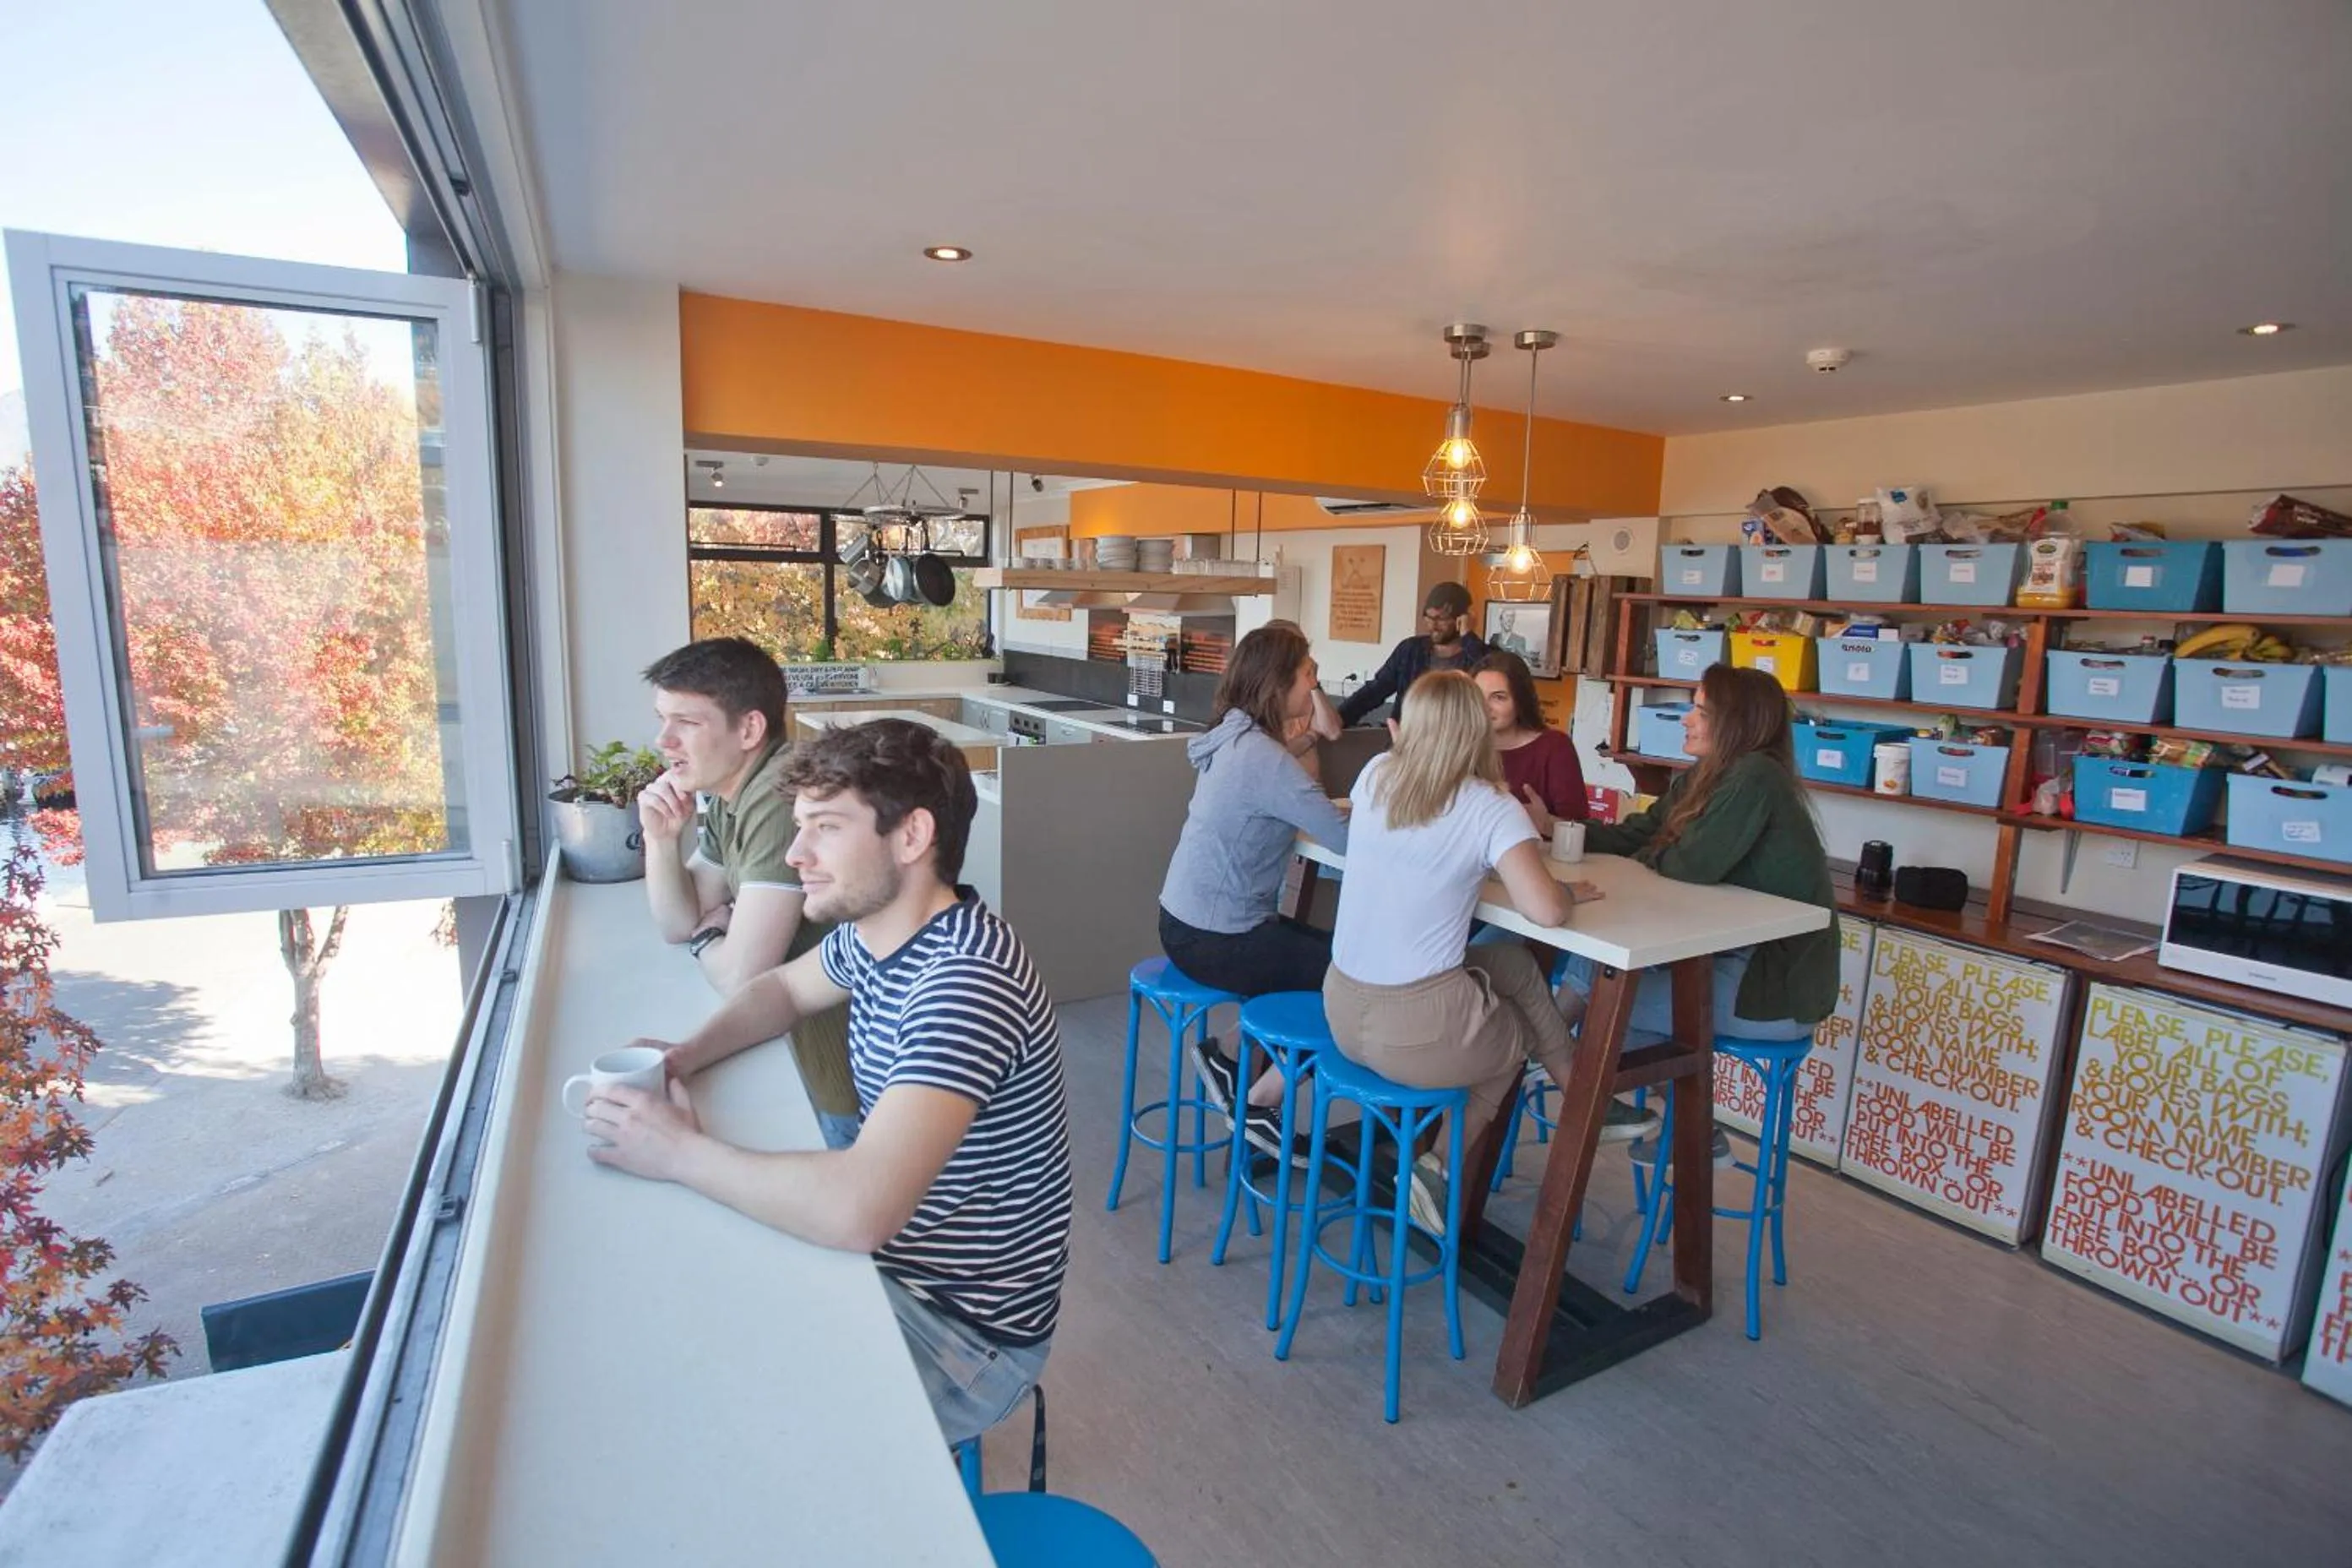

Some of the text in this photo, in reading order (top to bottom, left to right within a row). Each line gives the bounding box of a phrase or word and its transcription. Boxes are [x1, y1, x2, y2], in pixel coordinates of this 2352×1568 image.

[1873, 956, 2022, 1016] LABEL ALL OF
[1876, 939, 1954, 977] PLEASE,
[1961, 962, 2053, 1005] PLEASE,
[1867, 1010, 1923, 1043] YOUR
[1928, 1029, 2002, 1068] NAME
[1871, 993, 1889, 1014] &
[1890, 999, 1962, 1037] BOXES
[1965, 1020, 2039, 1062] WITH;
[1892, 982, 1953, 1015] YOUR
[1957, 1000, 2025, 1037] BAGS
[2089, 996, 2327, 1081] PLEASE, PLEASE,
[1814, 1077, 1837, 1099] BE
[1861, 1026, 1932, 1065] ROOM
[1939, 1051, 2040, 1099] NUMBER
[1864, 1044, 2023, 1113] & CHECK-OUT.
[2087, 1015, 2284, 1089] LABEL ALL OF
[2113, 1044, 2288, 1117] YOUR BAGS
[1795, 1088, 1818, 1109] HE
[1797, 1107, 1826, 1130] OR
[1855, 1092, 2016, 1167] FOOD WILL BE
[2077, 1075, 2257, 1153] YOUR NAME
[2084, 1057, 2308, 1146] & BOXES WITH;
[1846, 1141, 1939, 1194] THROWN
[1848, 1124, 1893, 1158] FREE
[1965, 1171, 2004, 1200] OR
[1854, 1110, 1995, 1179] PUT INTO THE
[2070, 1092, 2311, 1190] ROOM NUMBER
[2076, 1116, 2284, 1206] & CHECK-OUT.
[2062, 1189, 2247, 1282] PUT INTO THE
[2063, 1170, 2278, 1269] FOOD WILL BE
[2050, 1222, 2171, 1293] THROWN
[2051, 1206, 2110, 1248] FREE
[2210, 1272, 2261, 1308] OR
